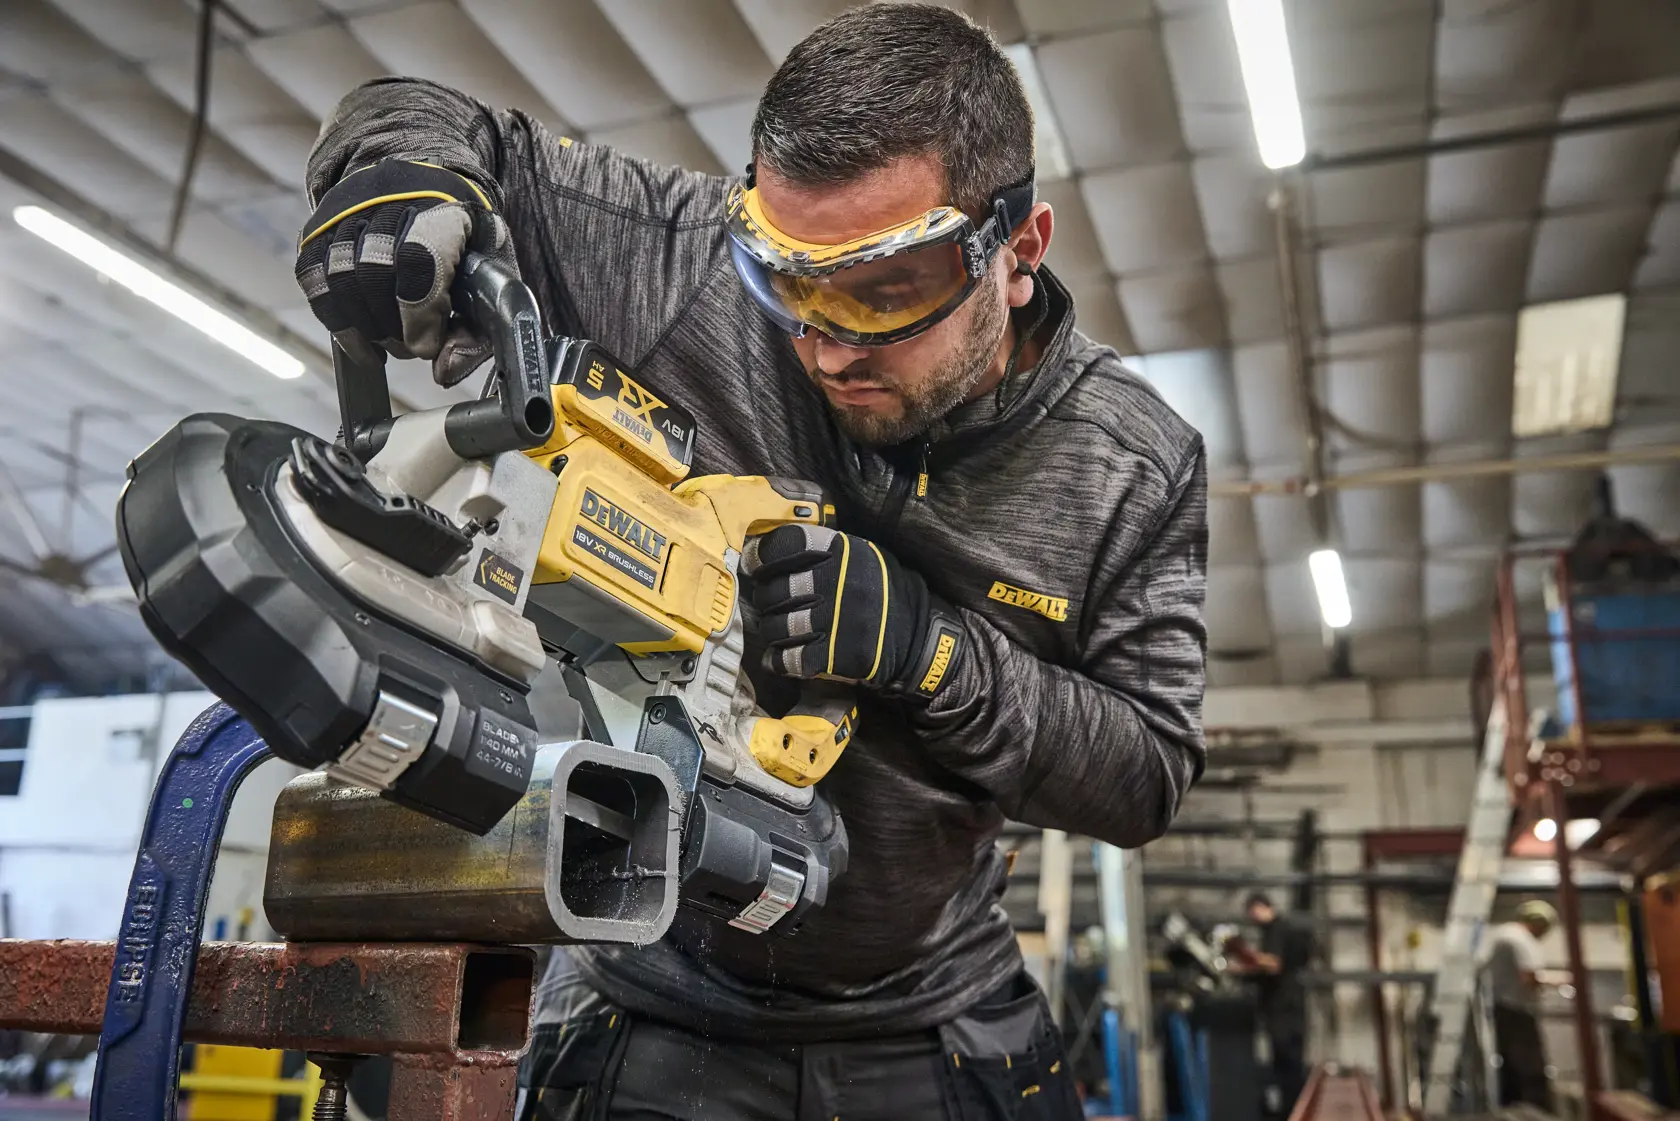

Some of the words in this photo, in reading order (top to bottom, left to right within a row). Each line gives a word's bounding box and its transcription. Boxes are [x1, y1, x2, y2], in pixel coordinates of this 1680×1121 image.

[592, 360, 605, 371] AH
[587, 368, 605, 391] 5
[615, 368, 668, 428] XR
[612, 407, 653, 444] DEWALT
[662, 418, 685, 442] 18V
[581, 488, 667, 562] DEWALT
[575, 529, 594, 548] 18V
[593, 539, 608, 556] XR
[608, 550, 656, 584] BRUSHLESS
[489, 572, 518, 595] TRACKING
[496, 566, 516, 584] BLADE
[987, 581, 1069, 622] DEWALT
[920, 634, 956, 693] DEWALT
[482, 720, 518, 744] BLADE
[480, 735, 501, 751] 140
[501, 745, 519, 760] MM
[476, 750, 514, 774] 44-7/8
